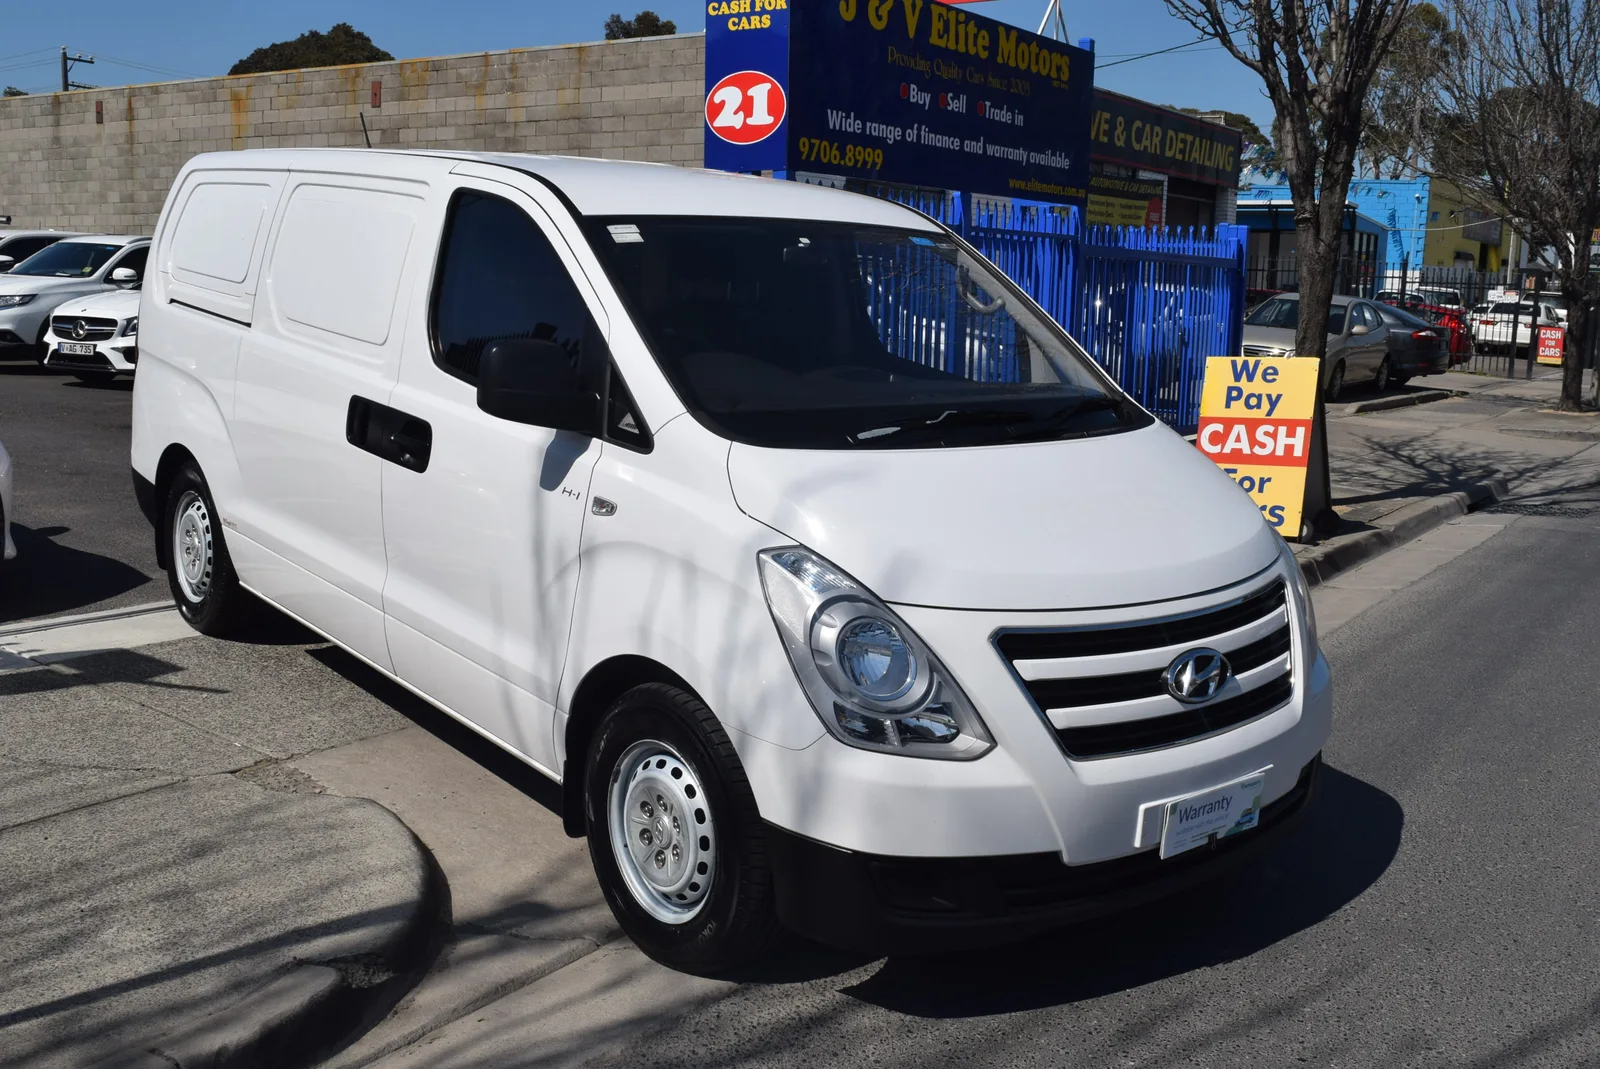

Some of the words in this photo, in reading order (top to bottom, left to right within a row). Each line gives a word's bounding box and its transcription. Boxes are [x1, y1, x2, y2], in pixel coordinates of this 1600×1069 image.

[708, 0, 751, 16] CASH
[754, 0, 787, 12] FOR
[728, 14, 771, 31] CARS
[867, 0, 894, 31] &
[902, 0, 923, 39] V
[929, 4, 989, 59] Elite
[996, 26, 1070, 81] Motors
[888, 46, 931, 78] Providing
[933, 58, 963, 84] Quality
[966, 67, 985, 84] Cars
[987, 73, 1007, 91] Since
[713, 82, 774, 129] 21
[910, 84, 931, 110] Buy
[946, 93, 966, 114] Sell
[985, 101, 1012, 124] Trade
[1015, 109, 1024, 126] in
[799, 136, 883, 170] 9706.8999
[827, 109, 862, 134] Wide
[866, 117, 902, 144] range
[905, 124, 918, 142] of
[921, 124, 960, 150] finance
[964, 136, 983, 154] and
[986, 142, 1028, 166] warranty
[1029, 149, 1070, 169] available
[1114, 115, 1127, 148] &
[1131, 120, 1163, 155] CAR
[1165, 129, 1235, 172] DETAILING
[1009, 177, 1086, 199] www.elitemotors.com.au
[1540, 329, 1561, 339] CASH
[1539, 347, 1560, 357] CARS
[1230, 359, 1279, 384] We
[1224, 386, 1283, 417] Pay
[1200, 422, 1306, 457] CASH
[1179, 795, 1233, 824] Warranty
